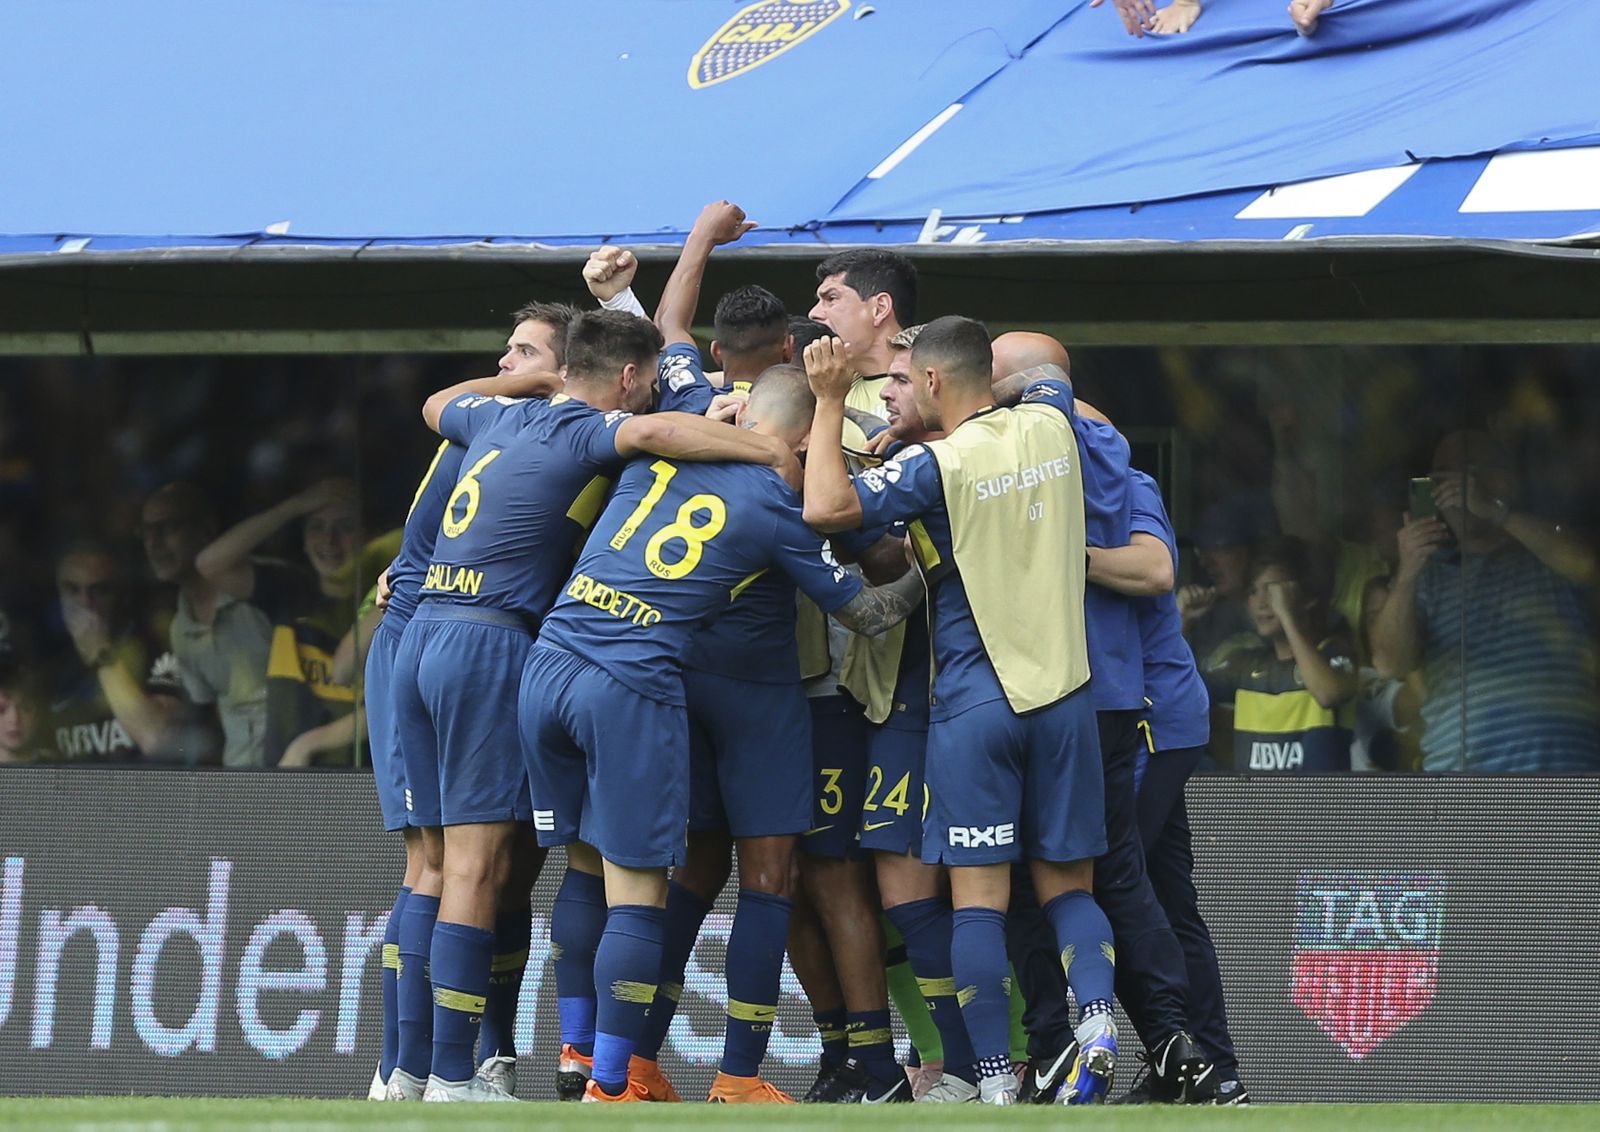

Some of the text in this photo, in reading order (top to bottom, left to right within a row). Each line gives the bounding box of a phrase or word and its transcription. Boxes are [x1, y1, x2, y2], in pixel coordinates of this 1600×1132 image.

[718, 21, 816, 44] CABJ
[442, 449, 502, 539] 6
[975, 455, 1071, 501] SUPLENTES
[609, 459, 728, 582] 18
[1028, 501, 1045, 521] 07
[614, 526, 632, 547] RUS
[422, 564, 484, 596] GALLAN
[649, 559, 671, 578] RUS
[566, 573, 662, 627] BENEDETTO
[820, 768, 844, 814] 3
[863, 765, 910, 816] 24
[949, 822, 1015, 848] AXE
[1312, 889, 1430, 941] TAG
